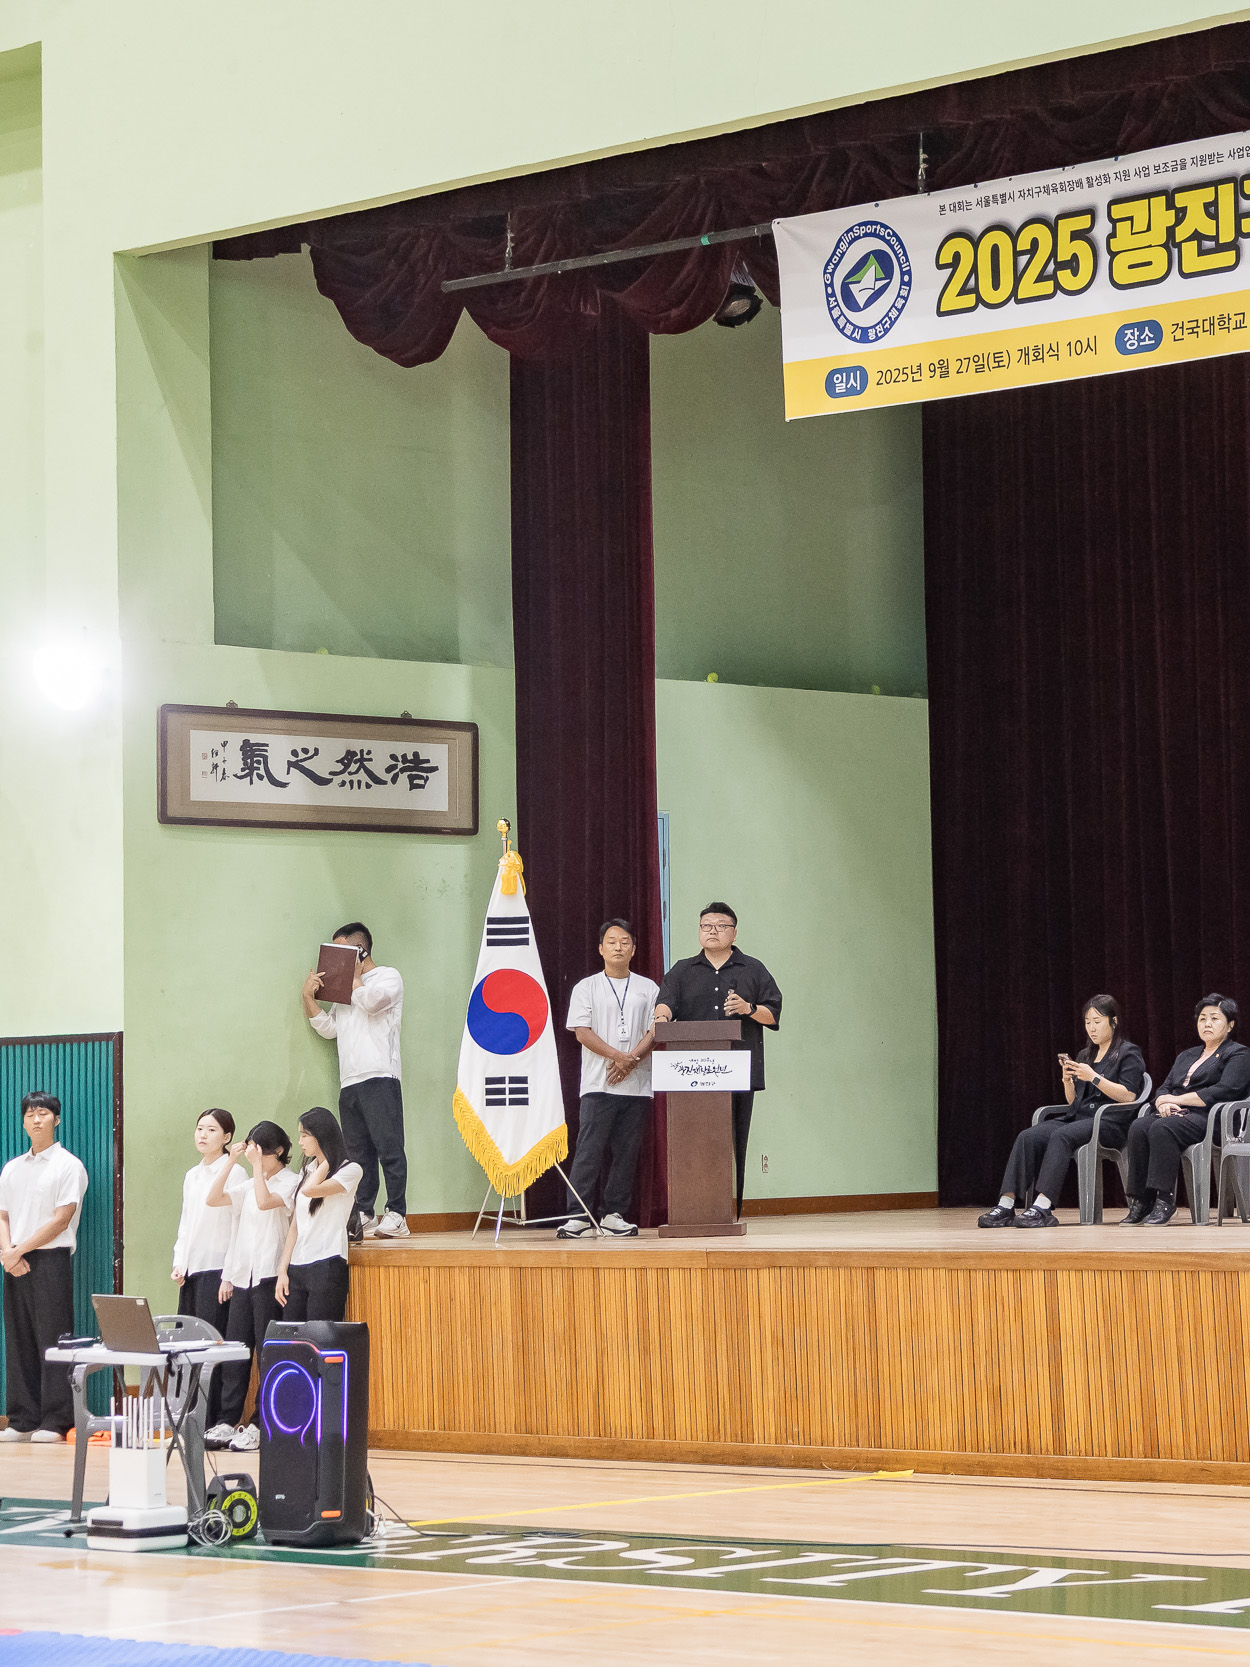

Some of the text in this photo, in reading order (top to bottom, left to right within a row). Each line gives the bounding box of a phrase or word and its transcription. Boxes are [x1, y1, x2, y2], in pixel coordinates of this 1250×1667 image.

[938, 204, 947, 216] 본
[949, 200, 973, 213] 대회는
[975, 191, 1015, 209] 서울특별시
[1017, 178, 1084, 201] 자치구체육회장배
[1085, 173, 1111, 189] 활성화
[1113, 169, 1131, 182] 지원
[1133, 165, 1151, 179] 사업
[1153, 158, 1188, 175] 보조금을
[1190, 151, 1225, 168] 지원받는
[824, 224, 910, 284] GwangjinSportsCouncil
[937, 212, 1098, 315] 2025
[828, 285, 910, 341] 서울특별시 광진구체육회
[832, 370, 861, 394] 일시
[875, 363, 923, 387] 2025년
[927, 358, 951, 379] 9월
[955, 350, 1012, 376] 27일(토)
[1016, 341, 1060, 366] 개회식
[1066, 335, 1098, 358] 10시
[1123, 328, 1156, 350] 장소
[1170, 311, 1247, 342] 건국대학교
